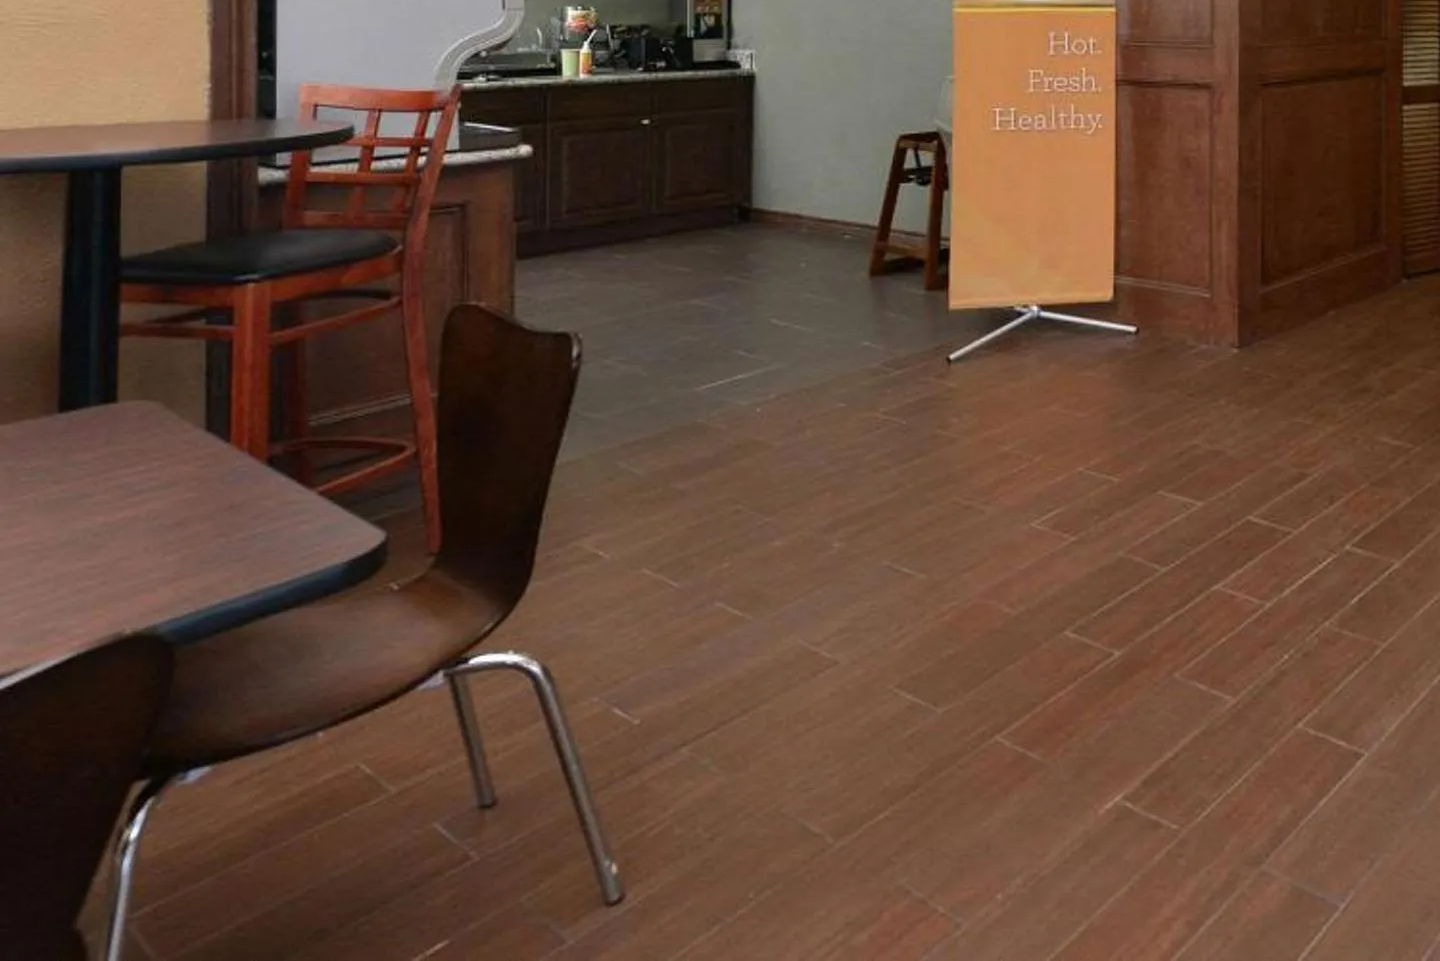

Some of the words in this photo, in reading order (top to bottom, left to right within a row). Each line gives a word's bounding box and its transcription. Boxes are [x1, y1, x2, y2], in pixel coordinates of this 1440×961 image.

[1048, 30, 1103, 56] Hot.
[1029, 67, 1103, 93] Fresh.
[992, 105, 1103, 134] Healthy.
